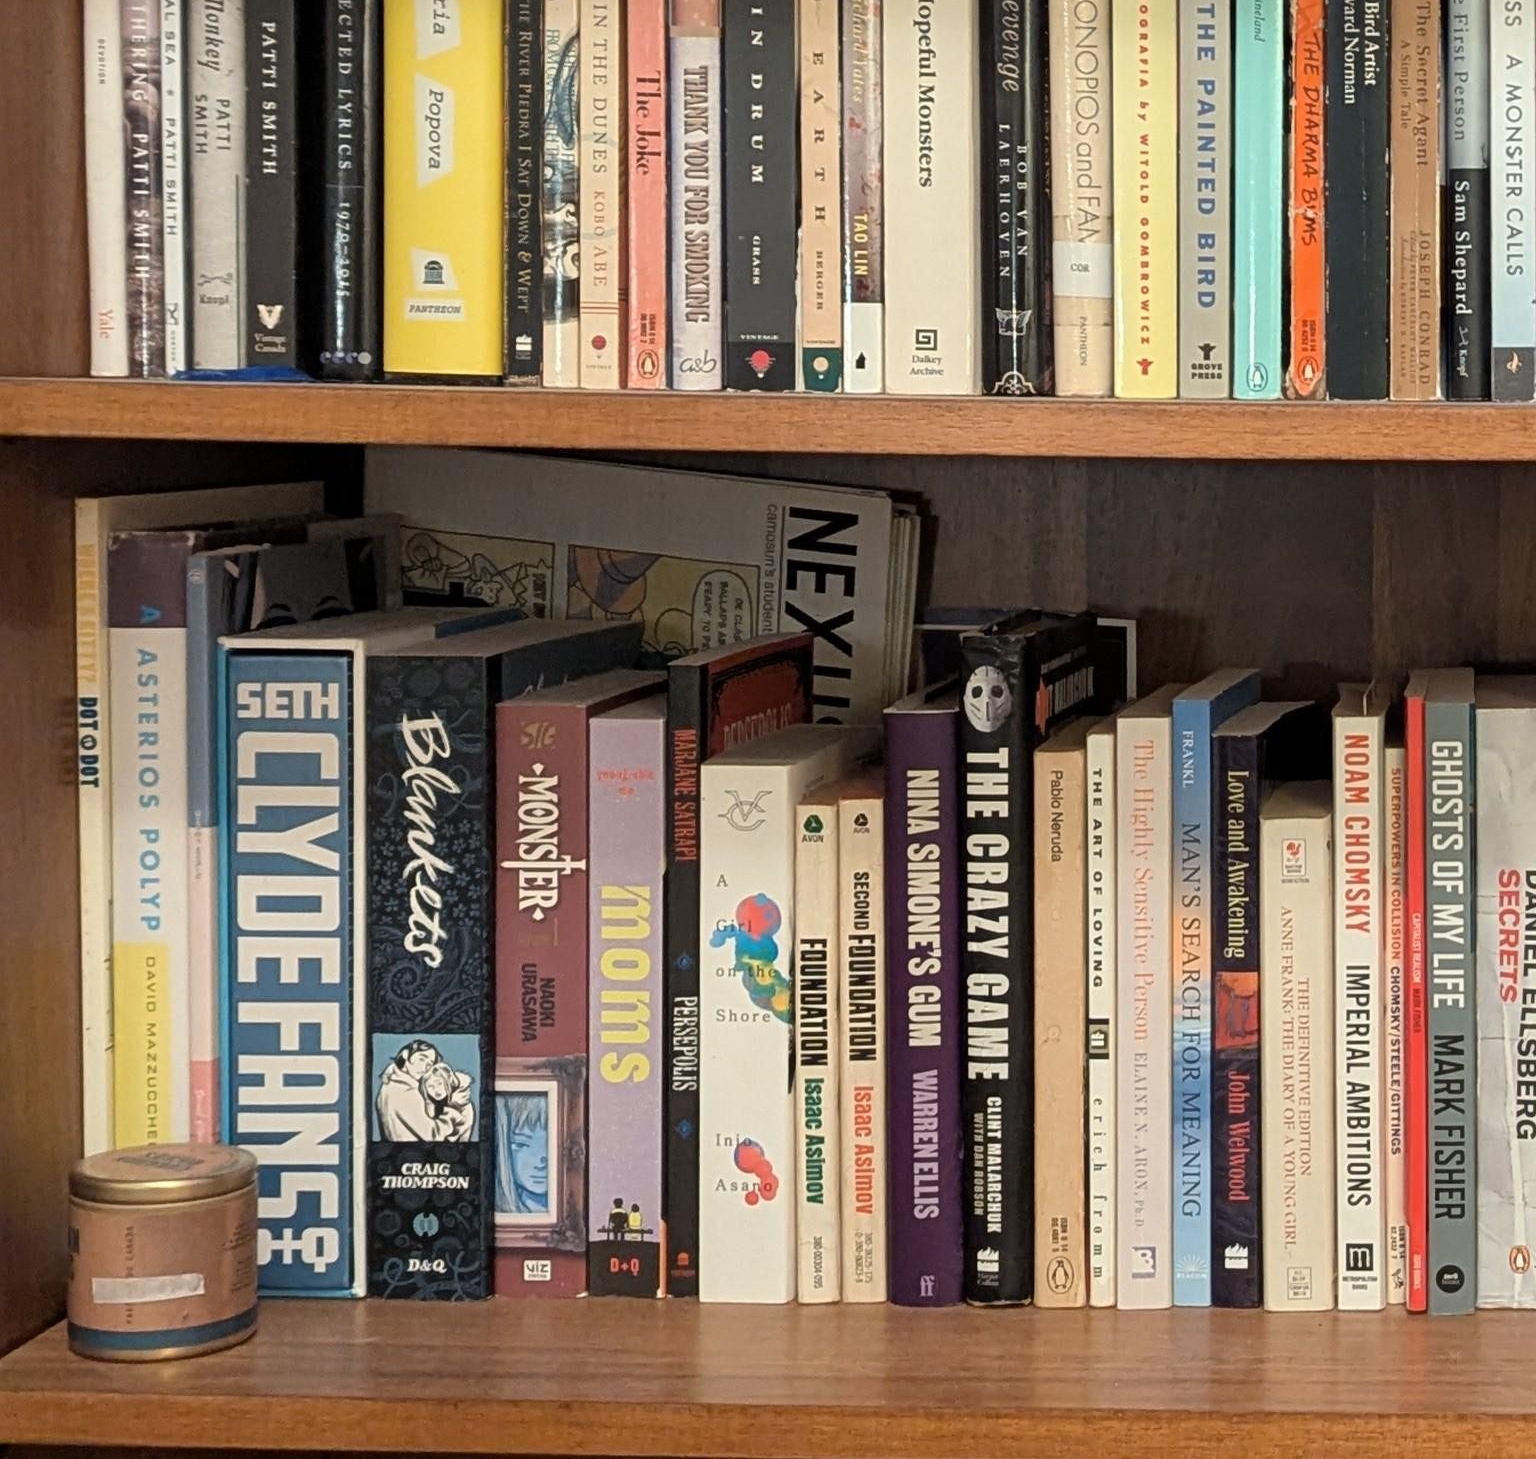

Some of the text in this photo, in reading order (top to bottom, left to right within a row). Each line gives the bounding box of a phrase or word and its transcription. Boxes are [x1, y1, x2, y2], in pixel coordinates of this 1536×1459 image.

[1342, 41, 1358, 105] Norman
[1363, 0, 1379, 37] Bird
[1363, 41, 1378, 86] Artist
[262, 22, 277, 176] PATTI SMITH
[427, 89, 445, 170] Popova
[632, 70, 662, 177] The Joke
[916, 85, 934, 189] Monsters
[1194, 3, 1216, 309] THE PAINTED BIRD
[1452, 180, 1470, 316] Sam Shepard
[408, 304, 463, 314] PANTHEON
[911, 354, 942, 366] Dalkey
[1191, 361, 1223, 372] GROVE
[909, 366, 944, 377] Archive
[1191, 371, 1223, 381] PRESS
[785, 506, 859, 725] NEXU
[137, 647, 160, 809] ASTERIOS
[237, 681, 341, 720] SETH
[138, 827, 162, 933] POLYP
[397, 710, 457, 971] Blankets
[502, 772, 587, 912] MONSTER
[1344, 734, 1370, 935] NOAM CHOMSKY
[1432, 740, 1464, 1009] GHOSTS OF MY LIFE
[906, 769, 940, 1048] NINA SIMONE'S GUM
[965, 747, 1011, 1083] THE CRAZY GAME
[1498, 868, 1520, 1004] SECRETS
[521, 964, 538, 1044] URASAWA
[538, 976, 555, 1027] NAOKI
[598, 883, 652, 1085] moms
[799, 938, 828, 1067] FOUNDATION
[804, 1077, 824, 1205] Isaac Asimov
[908, 1068, 939, 1220] WARREN ELLIS
[1344, 964, 1371, 1207] IMPERIAL AMBITIONS
[1433, 1035, 1465, 1220] MARK FISHER
[382, 1175, 470, 1190] THOMPSON
[400, 1163, 451, 1177] CRAIG
[408, 1258, 448, 1274] D&Q
